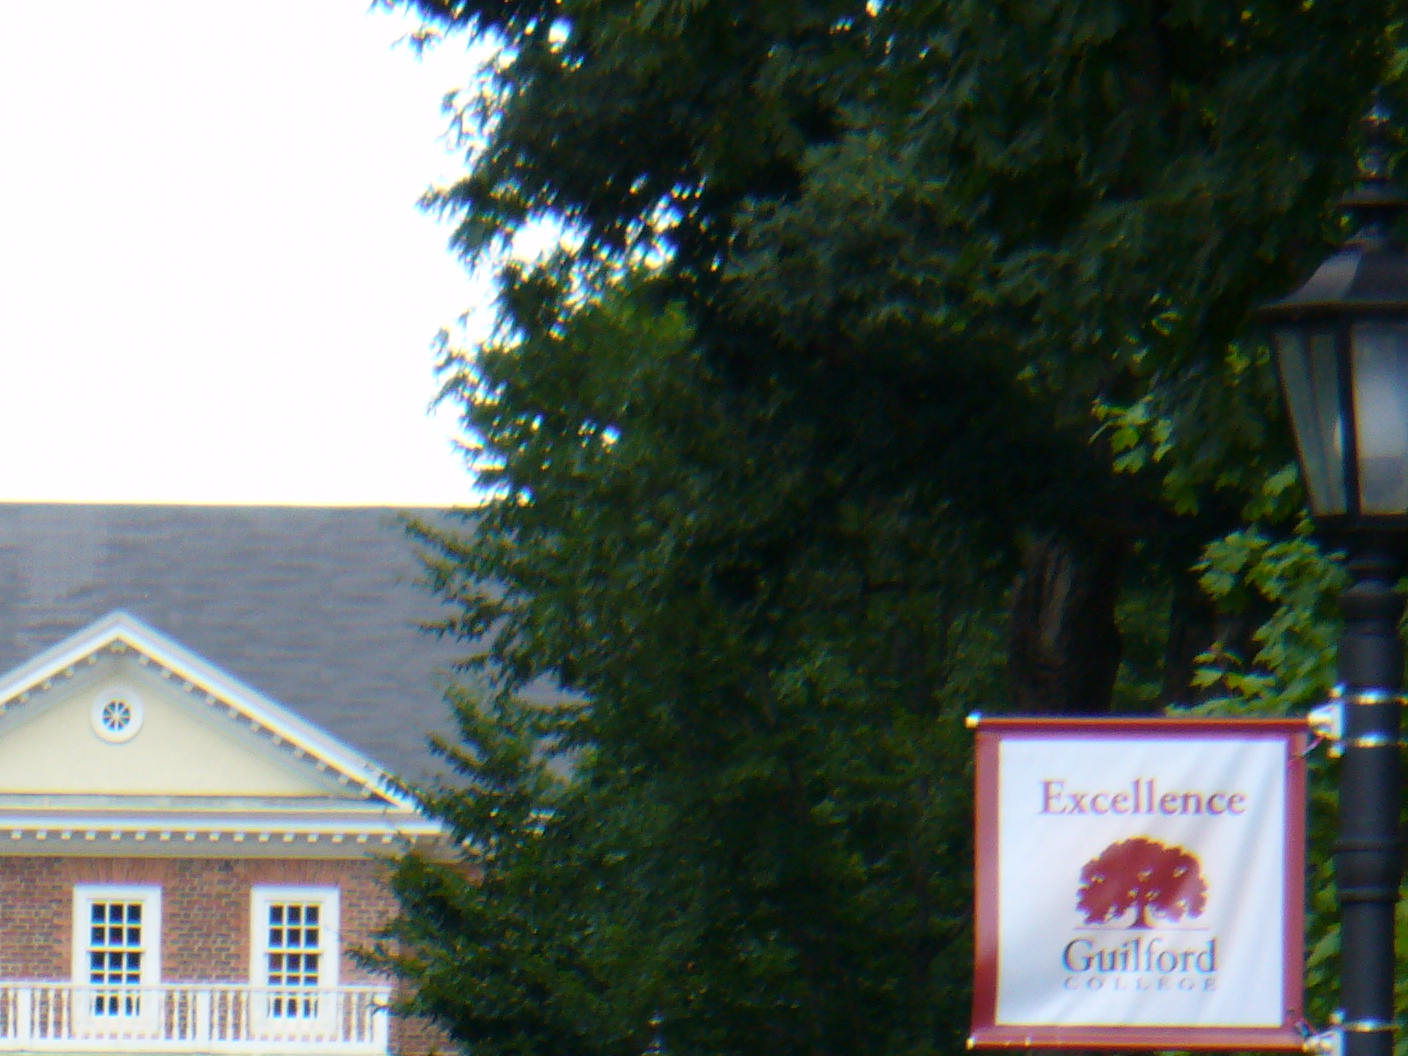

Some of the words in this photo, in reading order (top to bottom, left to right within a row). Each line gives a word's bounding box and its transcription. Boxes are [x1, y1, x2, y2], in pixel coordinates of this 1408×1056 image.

[1038, 778, 1248, 816] Excellence
[1062, 936, 1219, 974] Guilford
[1063, 976, 1219, 992] COLLEGE
